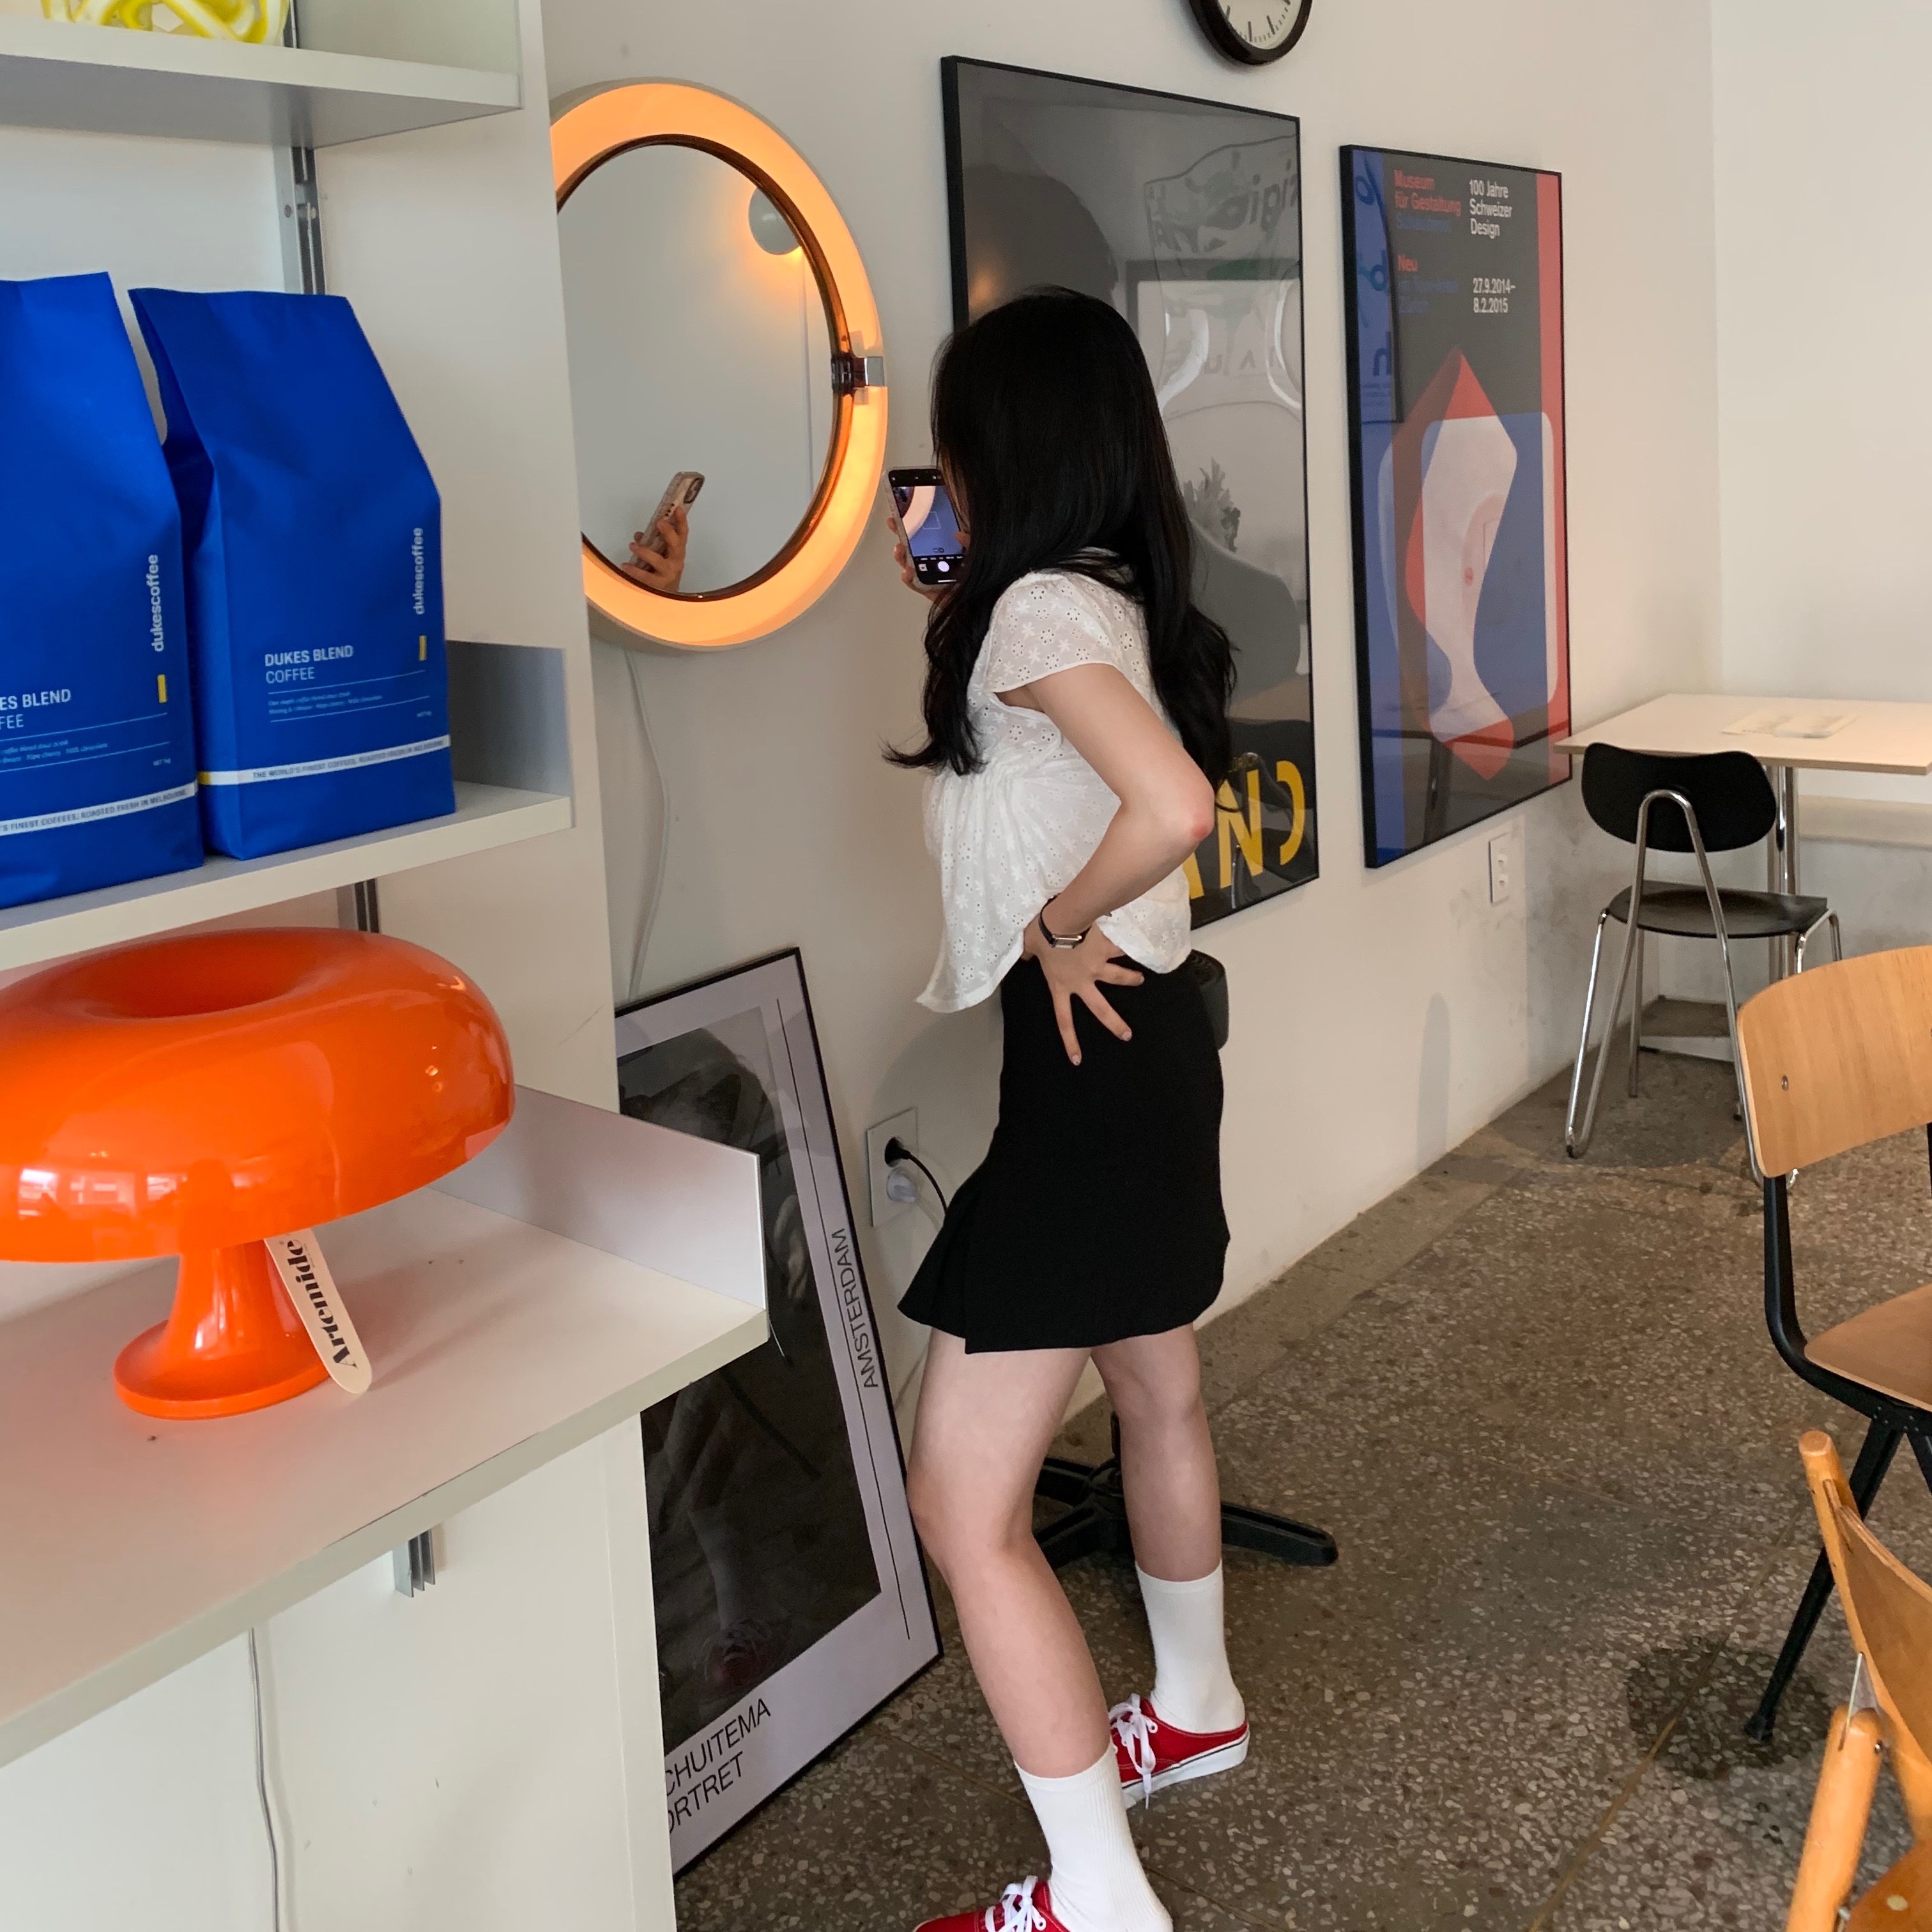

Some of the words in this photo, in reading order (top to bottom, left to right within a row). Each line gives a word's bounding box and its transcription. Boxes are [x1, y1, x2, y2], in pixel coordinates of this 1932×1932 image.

[1469, 180, 1485, 195] 100
[1486, 180, 1509, 199] Jahre
[1469, 198, 1512, 218] Schweizer
[1470, 218, 1500, 240] Design
[1473, 298, 1508, 313] 8.2.2015
[411, 527, 425, 615] dukescoffee
[146, 554, 165, 652] dukescoffee
[264, 649, 310, 667] DUKES
[313, 645, 354, 662] BLEND
[266, 667, 316, 684] COFFEE
[22, 689, 72, 708] BLEND
[287, 1239, 358, 1370] Artemide
[831, 1227, 878, 1388] AMSTERDAM
